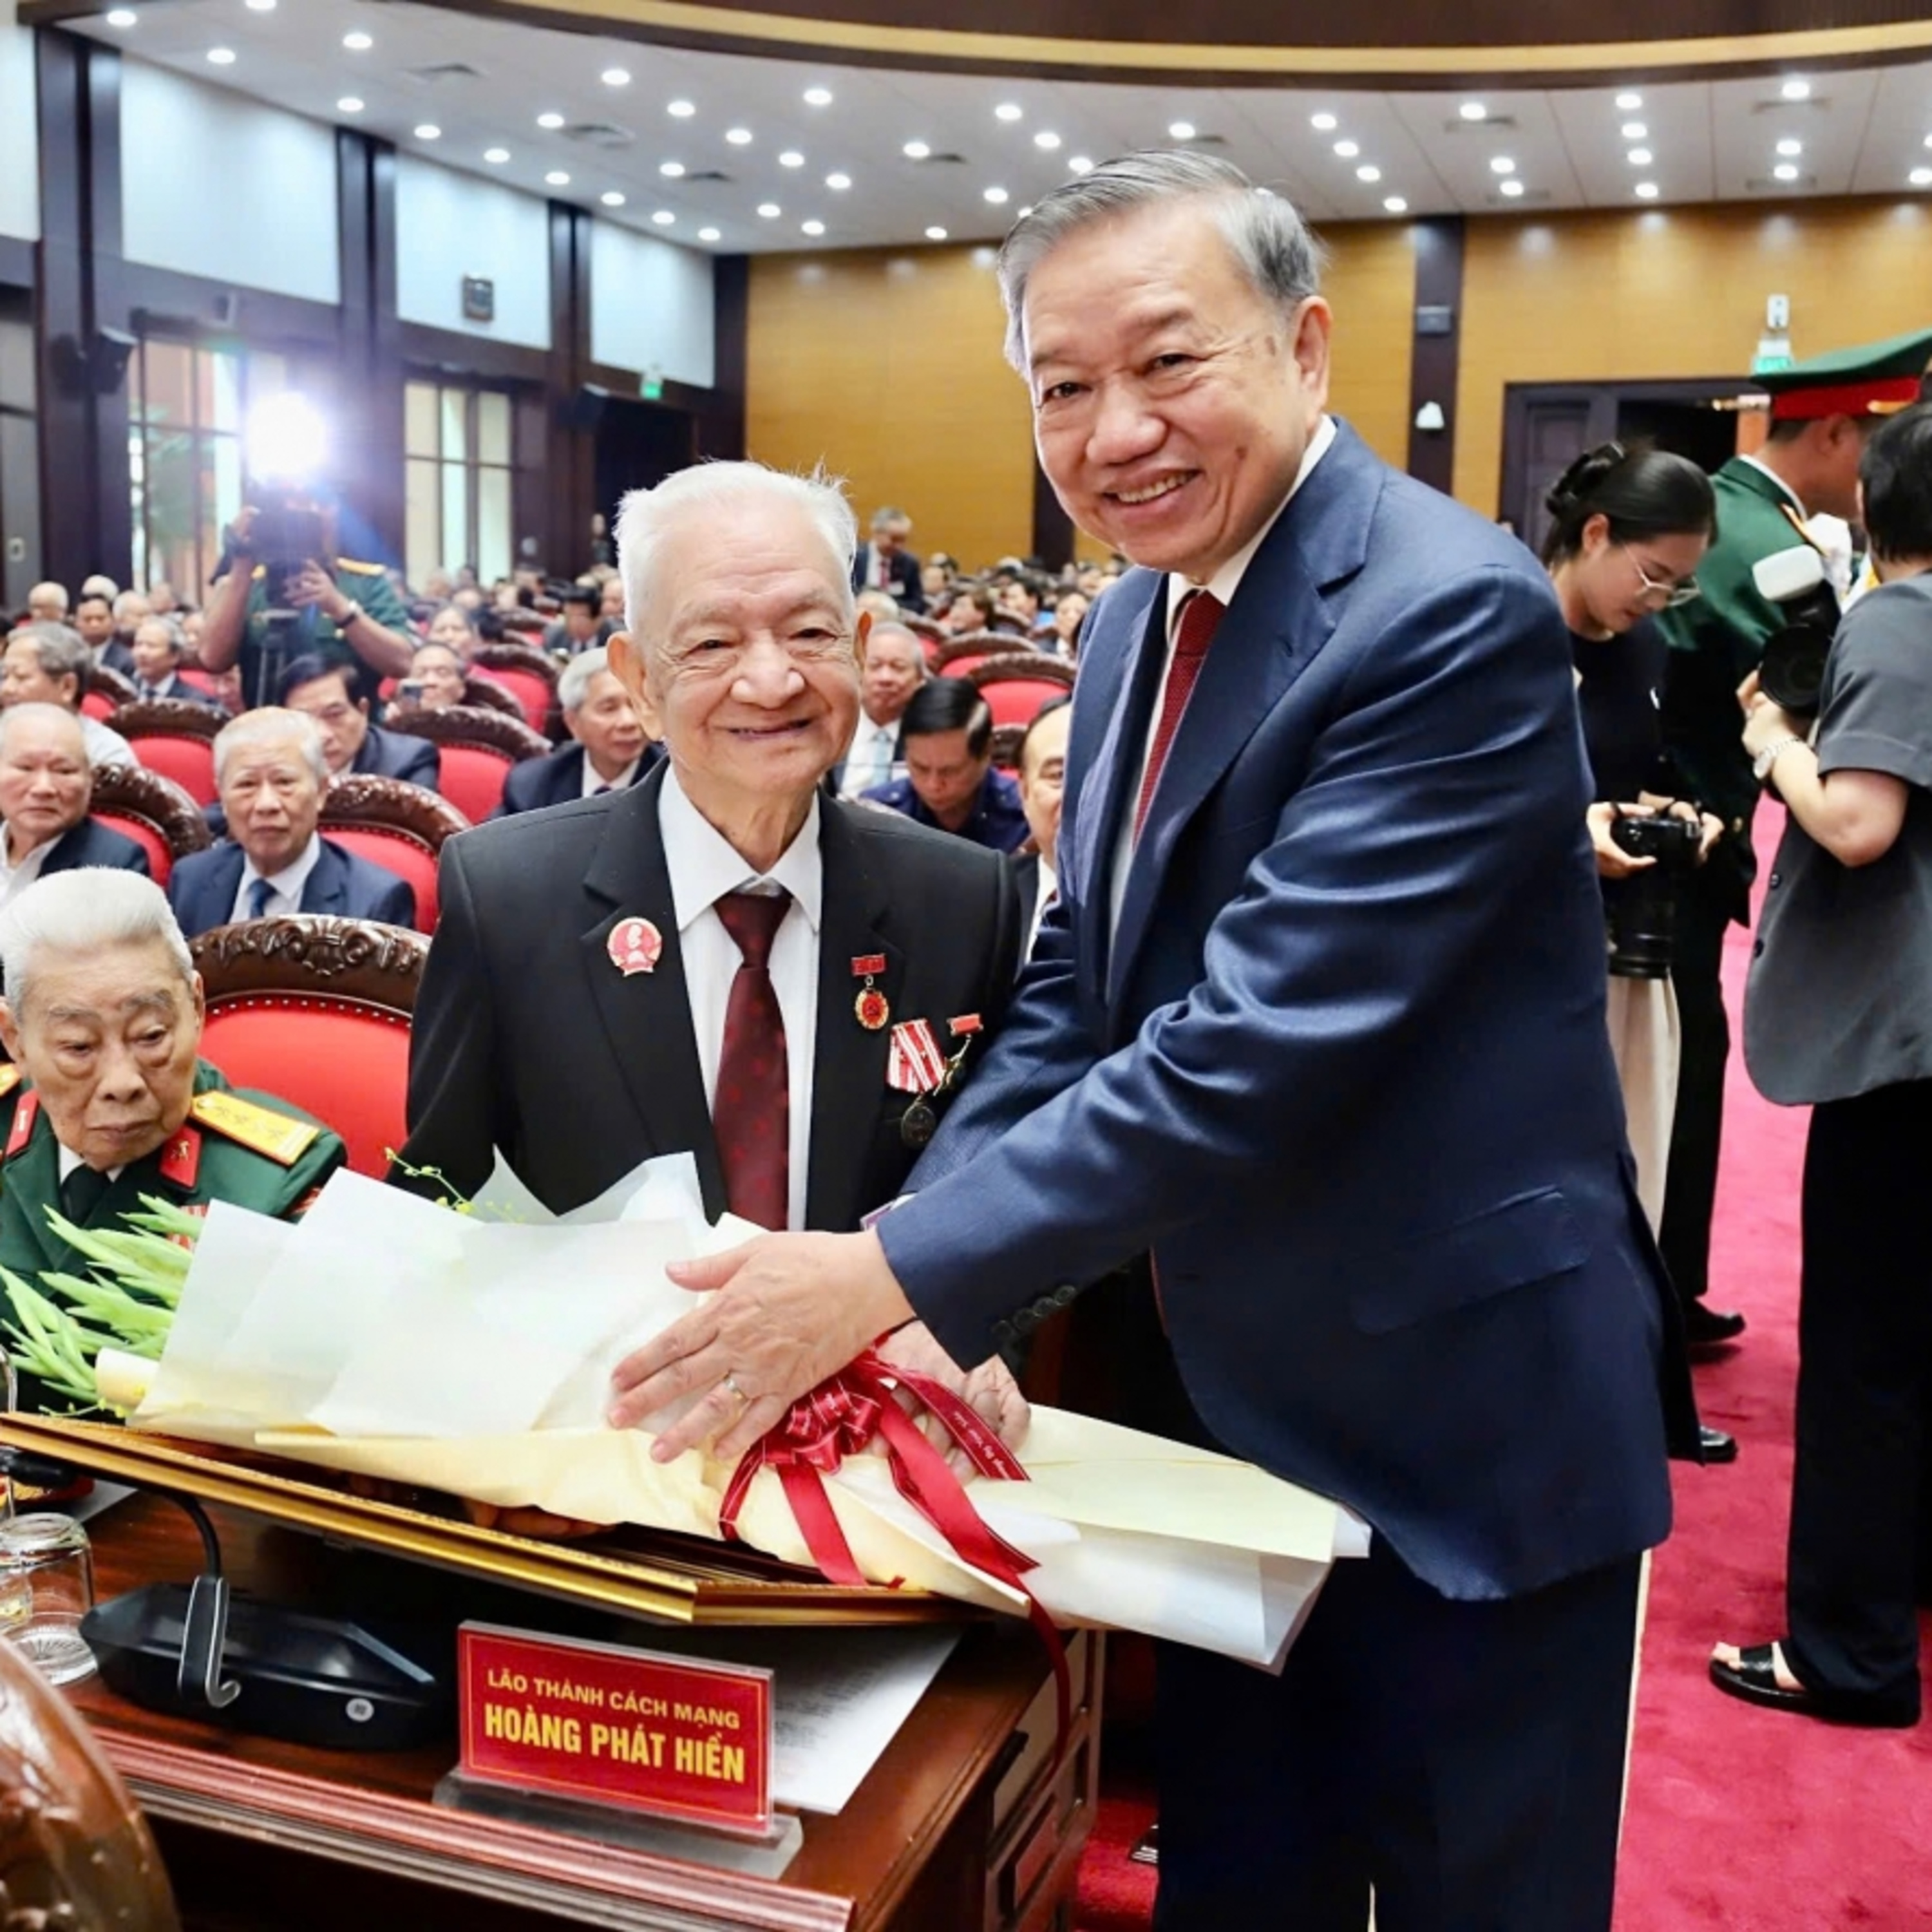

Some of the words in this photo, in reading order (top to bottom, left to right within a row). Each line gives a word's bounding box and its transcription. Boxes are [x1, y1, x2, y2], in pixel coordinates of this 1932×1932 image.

[488, 1667, 527, 1693] LÃO
[609, 1689, 667, 1718] CÁCH
[673, 1702, 740, 1729] MẠNG
[485, 1702, 582, 1754] HOÀNG
[590, 1722, 667, 1768] PHÁT
[675, 1730, 744, 1785] HIỀN
